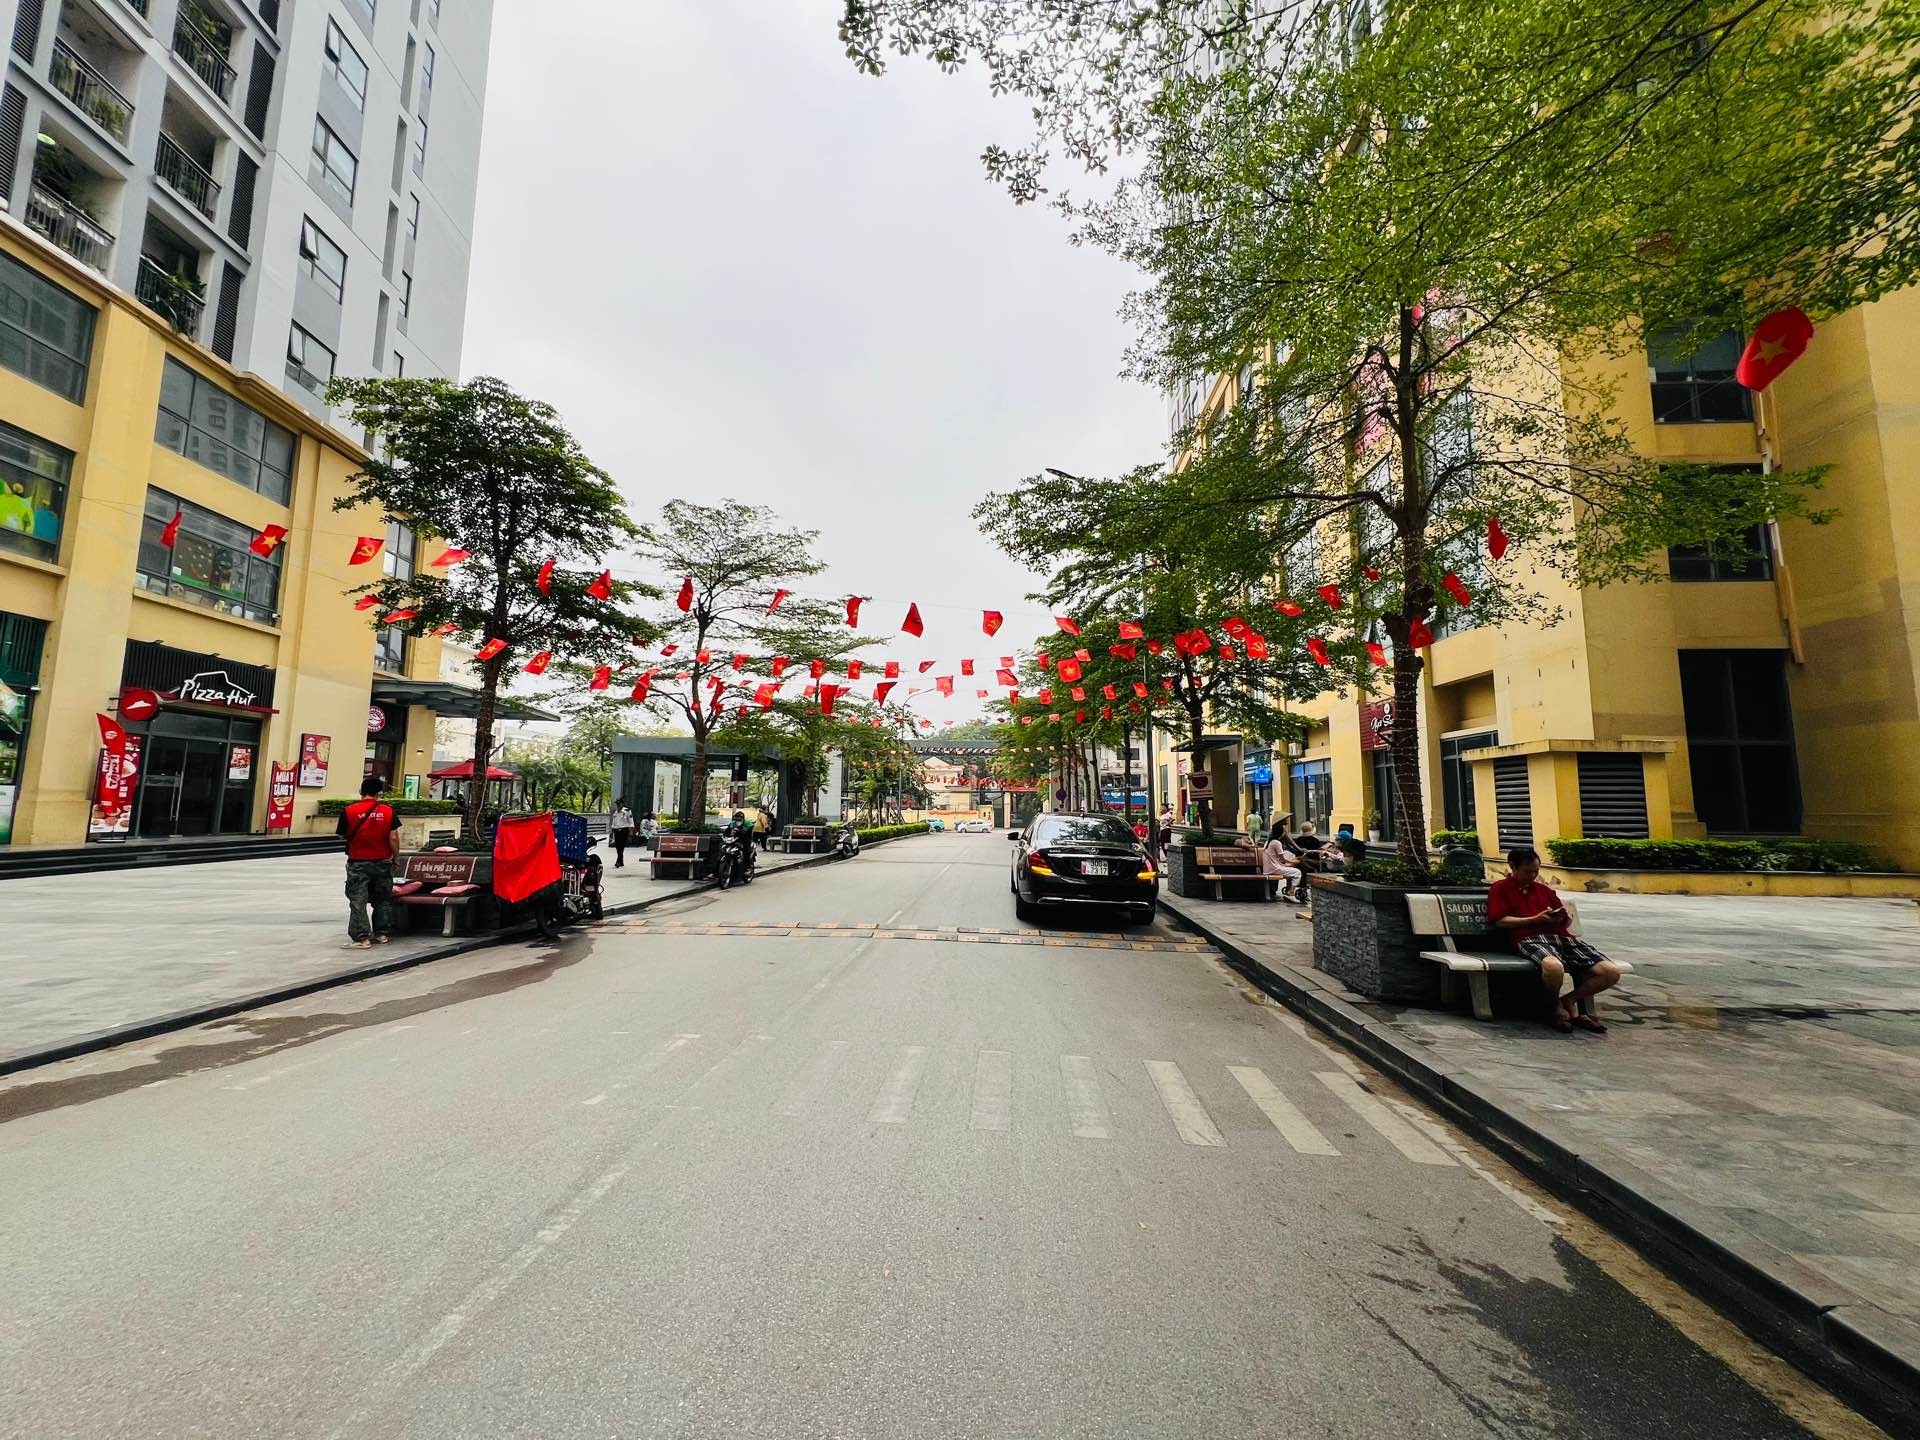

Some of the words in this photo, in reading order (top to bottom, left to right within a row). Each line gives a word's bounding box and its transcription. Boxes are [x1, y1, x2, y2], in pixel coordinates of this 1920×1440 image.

[180, 679, 226, 701] Pizza
[225, 689, 257, 705] Hut
[445, 864, 453, 872] 33
[458, 864, 466, 872] 34
[1446, 903, 1475, 913] SALON
[1476, 902, 1488, 913] TÓ
